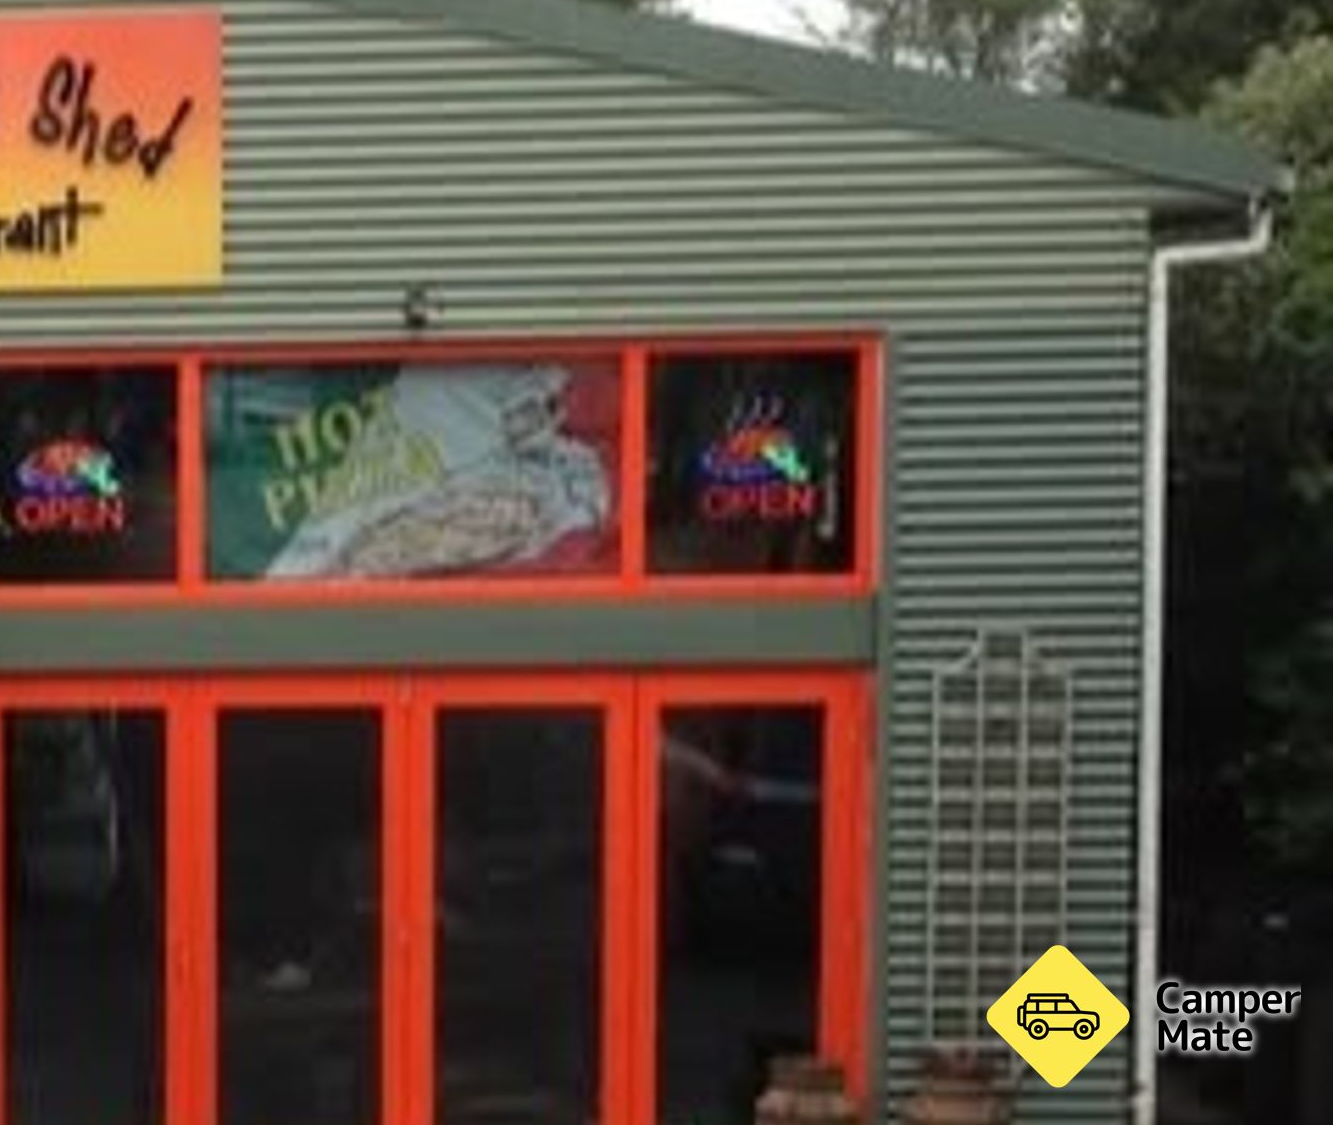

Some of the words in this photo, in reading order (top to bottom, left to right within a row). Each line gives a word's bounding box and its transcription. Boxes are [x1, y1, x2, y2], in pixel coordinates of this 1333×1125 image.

[29, 54, 194, 181] Shed
[15, 495, 125, 531] OPEN
[704, 480, 815, 518] OPEN
